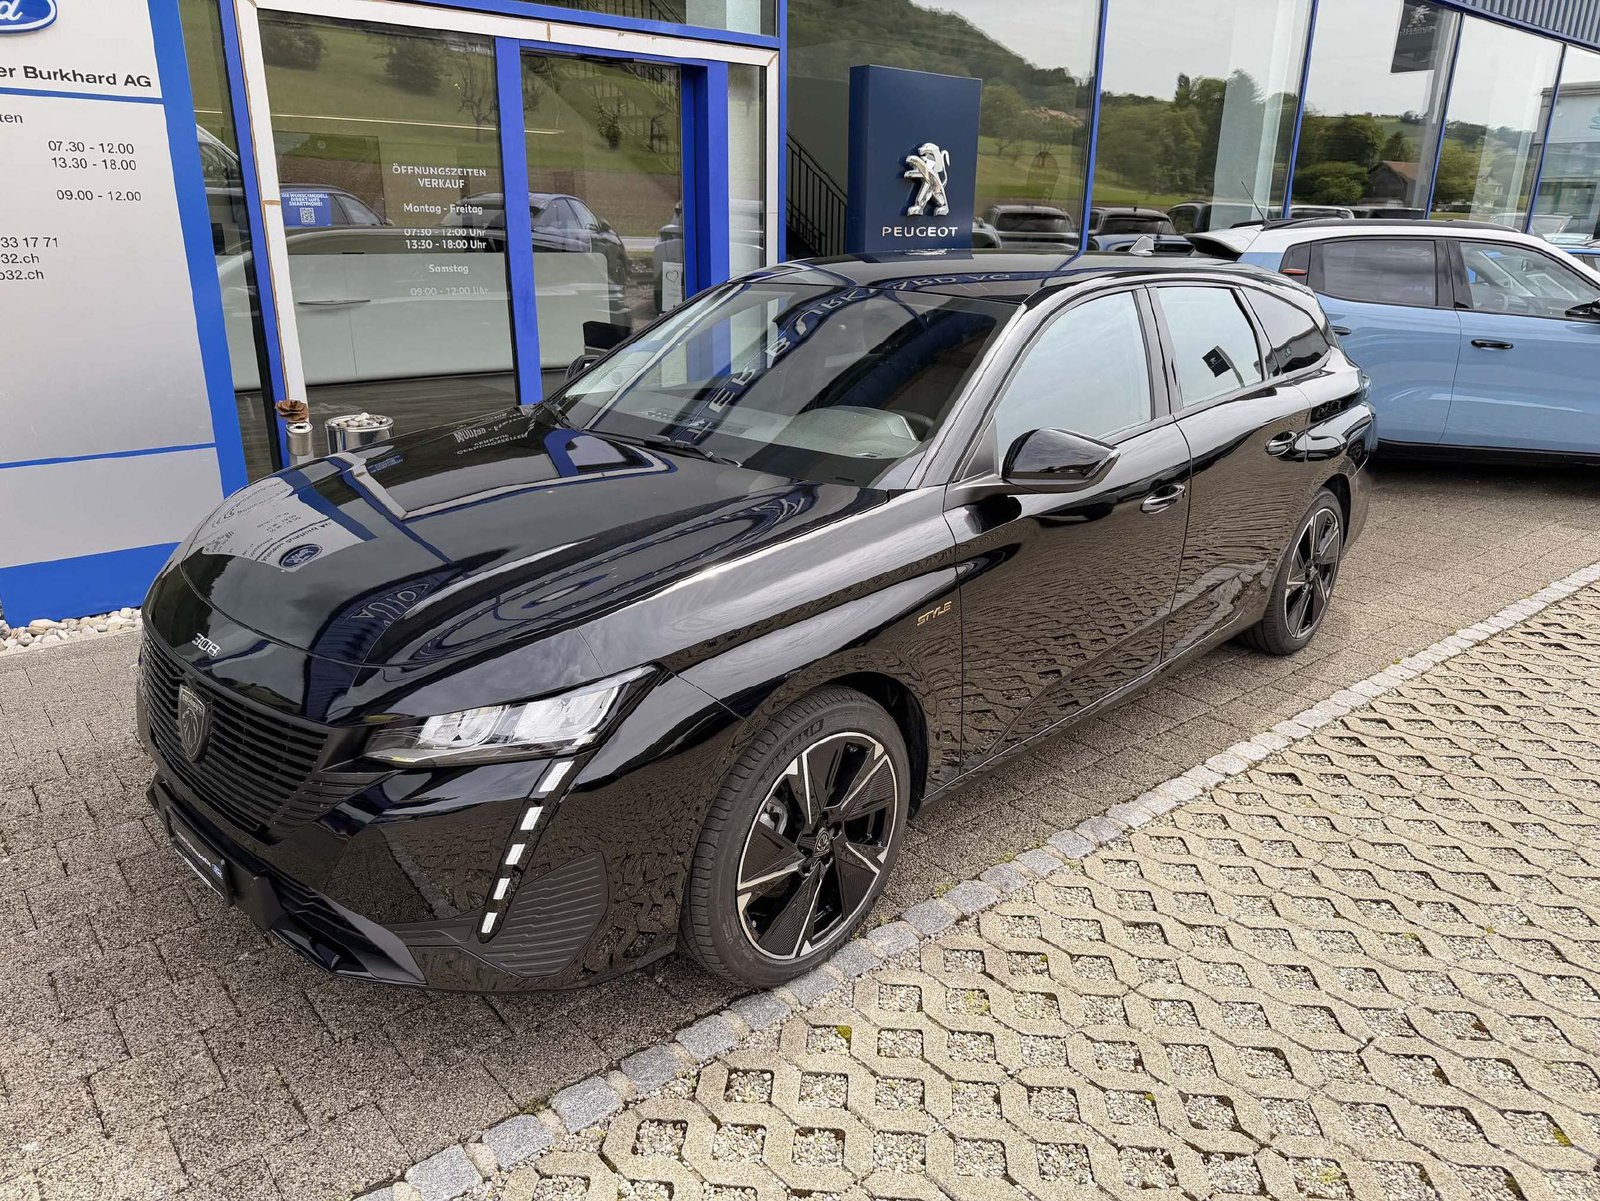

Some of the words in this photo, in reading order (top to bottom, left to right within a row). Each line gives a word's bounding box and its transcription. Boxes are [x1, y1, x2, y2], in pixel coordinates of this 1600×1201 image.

[23, 65, 117, 86] Burkhard
[123, 74, 152, 88] AG
[48, 140, 85, 153] 07.30
[98, 142, 134, 154] 12.00
[51, 156, 87, 169] 13.30
[101, 158, 136, 170] 18.00
[392, 162, 487, 177] ÖFFNUNGSZEITEN
[417, 177, 465, 189] VERKAUF
[56, 189, 93, 201] 09.00
[107, 190, 141, 201] 12.00
[403, 203, 442, 215] Montag
[449, 203, 483, 216] Freitag
[404, 228, 432, 237] 07:30
[442, 228, 467, 237] 12:00
[469, 228, 486, 237] Uhr
[881, 226, 959, 237] PEUGEOT
[0, 236, 19, 248] 33
[22, 236, 39, 248] 17
[43, 236, 58, 248] 71
[405, 239, 433, 249] 13:30
[442, 239, 468, 249] 18:00
[470, 239, 487, 249] Uhr
[428, 264, 469, 275] Samstag
[410, 287, 438, 296] 09:00
[446, 286, 471, 296] 12:00
[472, 286, 489, 295] Uhr
[916, 600, 952, 627] STYLE
[191, 632, 221, 657] 308
